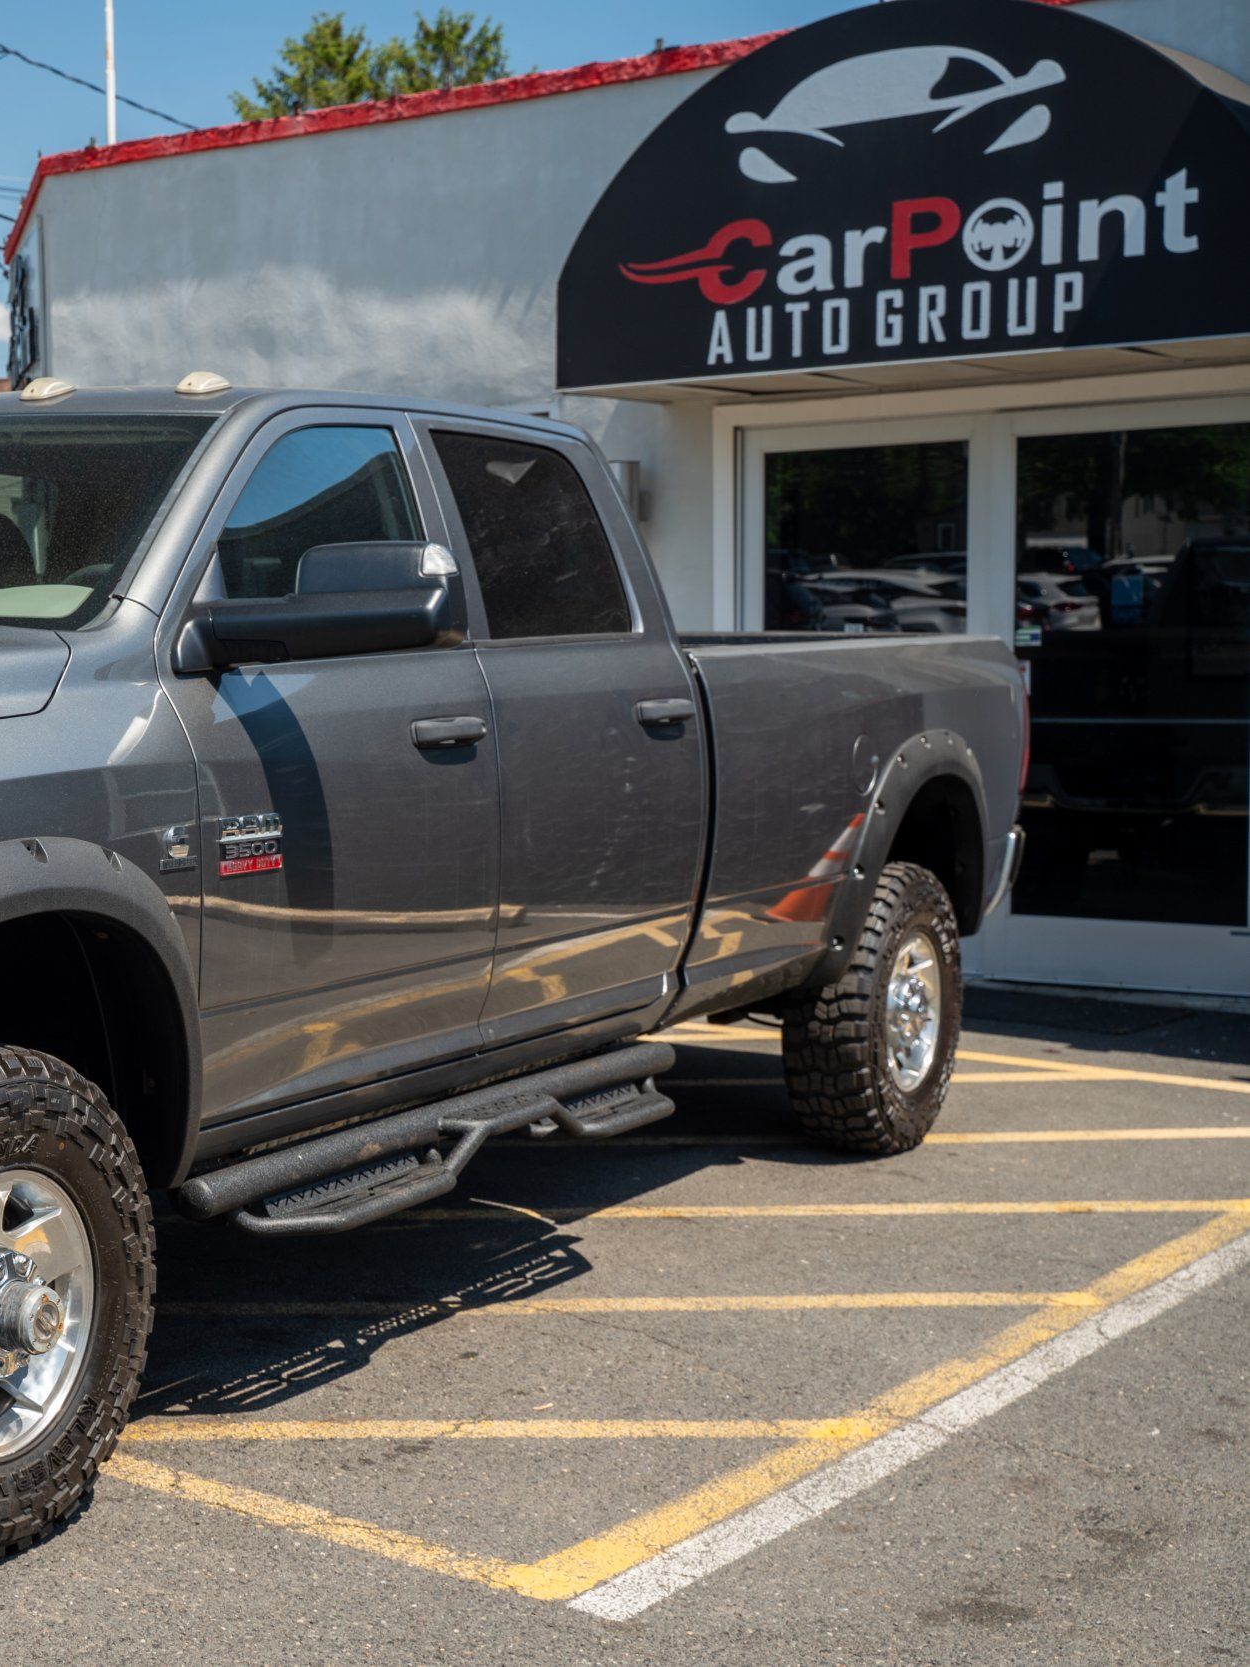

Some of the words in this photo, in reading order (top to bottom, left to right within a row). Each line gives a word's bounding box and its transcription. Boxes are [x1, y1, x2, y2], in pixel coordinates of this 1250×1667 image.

[618, 168, 1199, 305] CarPoint
[707, 297, 849, 366] AUTO
[875, 272, 1084, 347] GROUP
[219, 813, 283, 841] RAM
[225, 840, 278, 859] 3500
[12, 1394, 100, 1492] KLEVER
